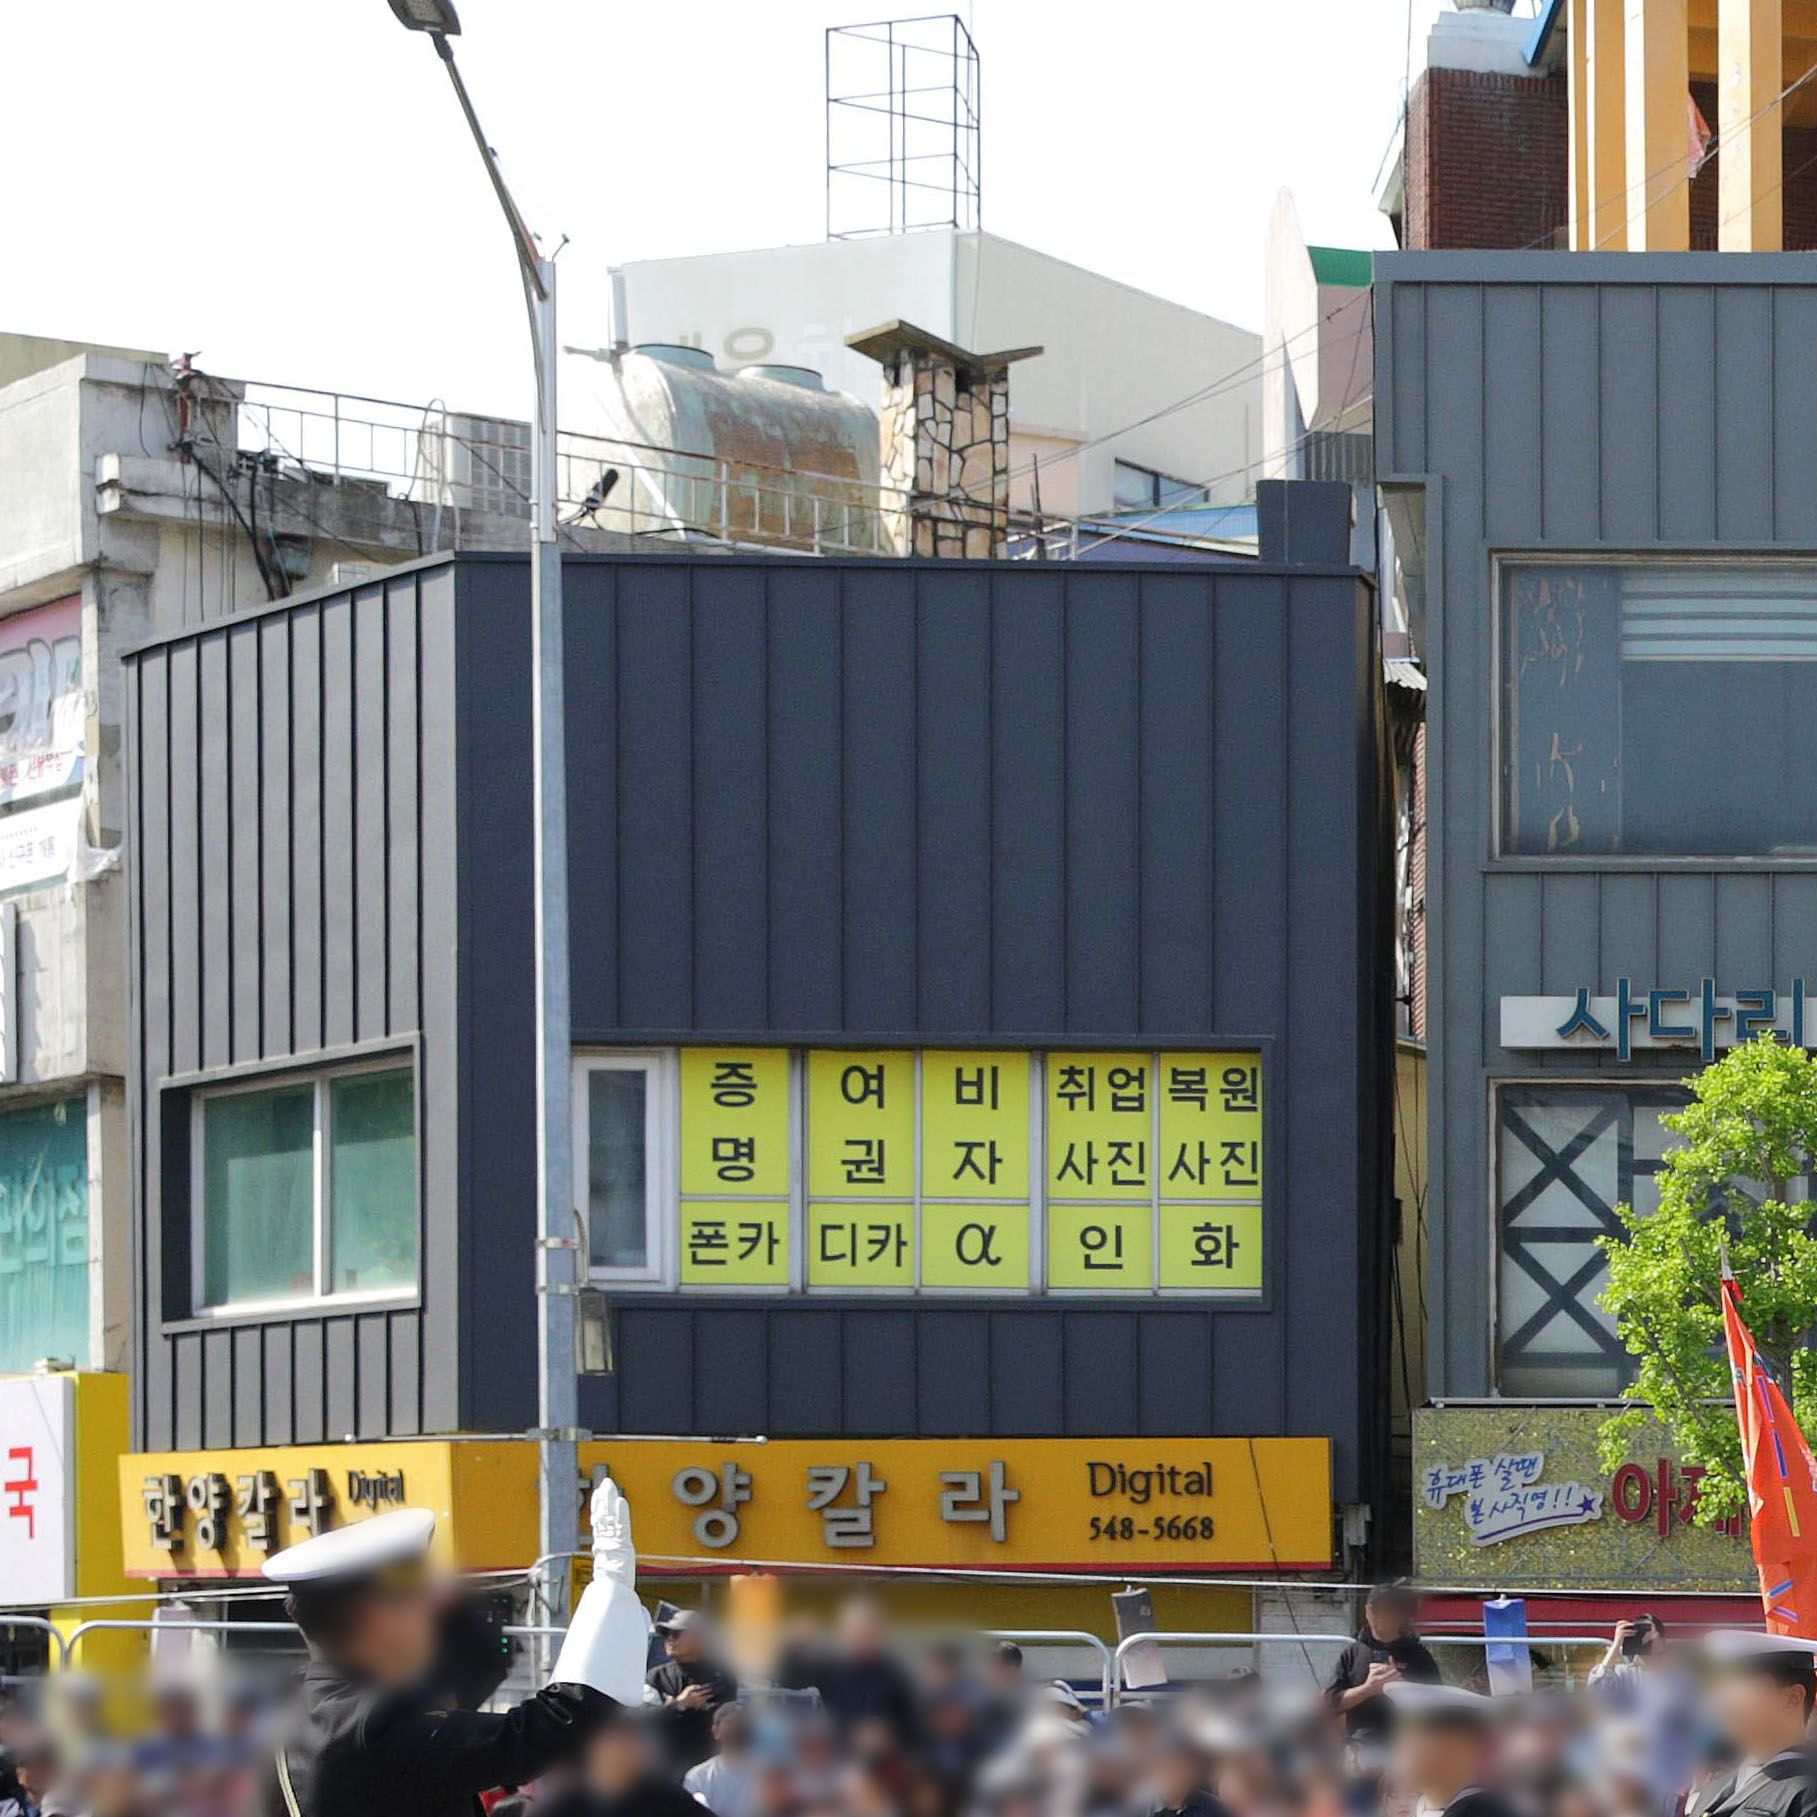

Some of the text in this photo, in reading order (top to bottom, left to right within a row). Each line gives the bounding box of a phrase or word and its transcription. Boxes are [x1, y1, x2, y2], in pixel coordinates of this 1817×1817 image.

[1555, 977, 1808, 1062] 사다리
[1056, 1066, 1259, 1112] 취업 복원
[1056, 1139, 1260, 1187] 사진 사진
[688, 1220, 780, 1265] 폰카
[819, 1221, 908, 1267] 디카
[4, 1446, 38, 1539] 국
[1087, 1460, 1214, 1502] Digital
[142, 1467, 331, 1551] 한양칼라
[1088, 1514, 1215, 1541] 548-5668
